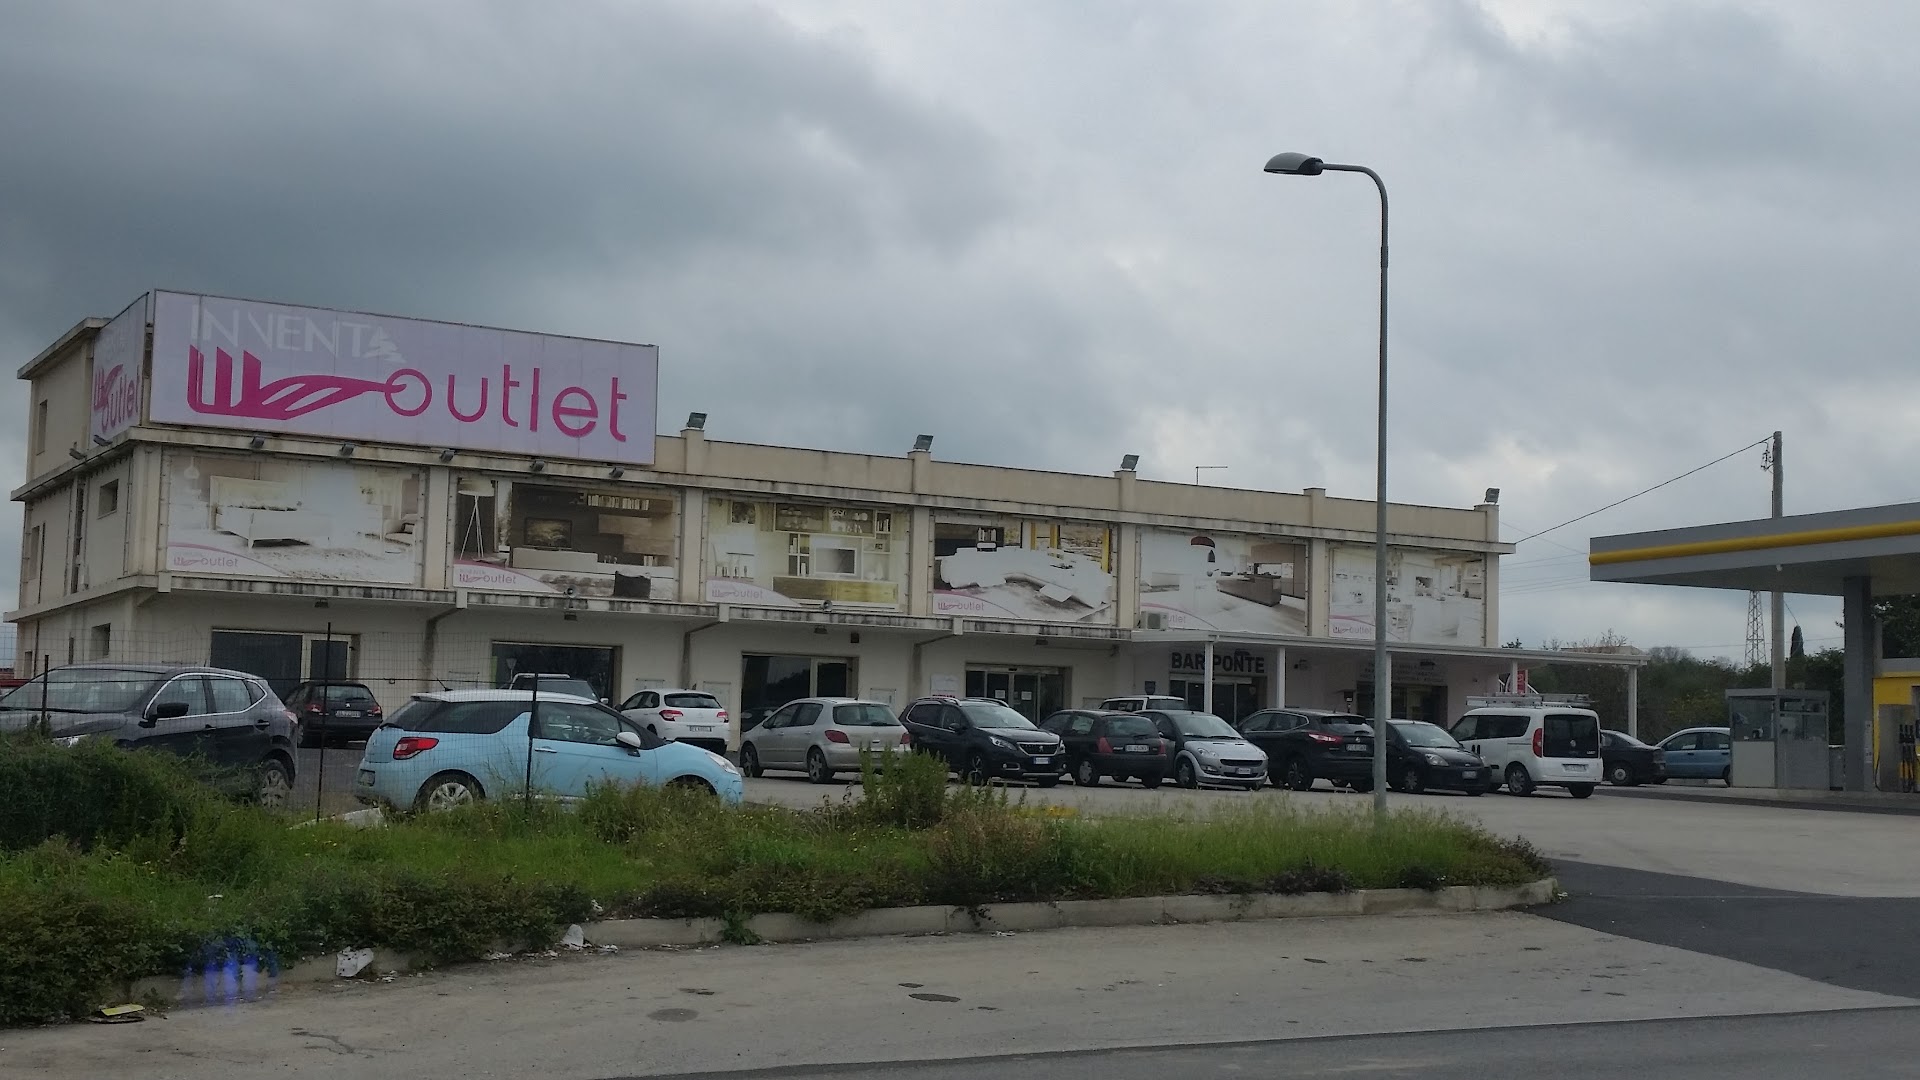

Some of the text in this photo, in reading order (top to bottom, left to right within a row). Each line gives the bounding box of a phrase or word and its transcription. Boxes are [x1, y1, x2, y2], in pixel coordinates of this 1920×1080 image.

[384, 365, 628, 442] outlet
[200, 556, 239, 568] outlet
[483, 574, 517, 584] outlet
[1171, 651, 1265, 674] BAR PONTE
